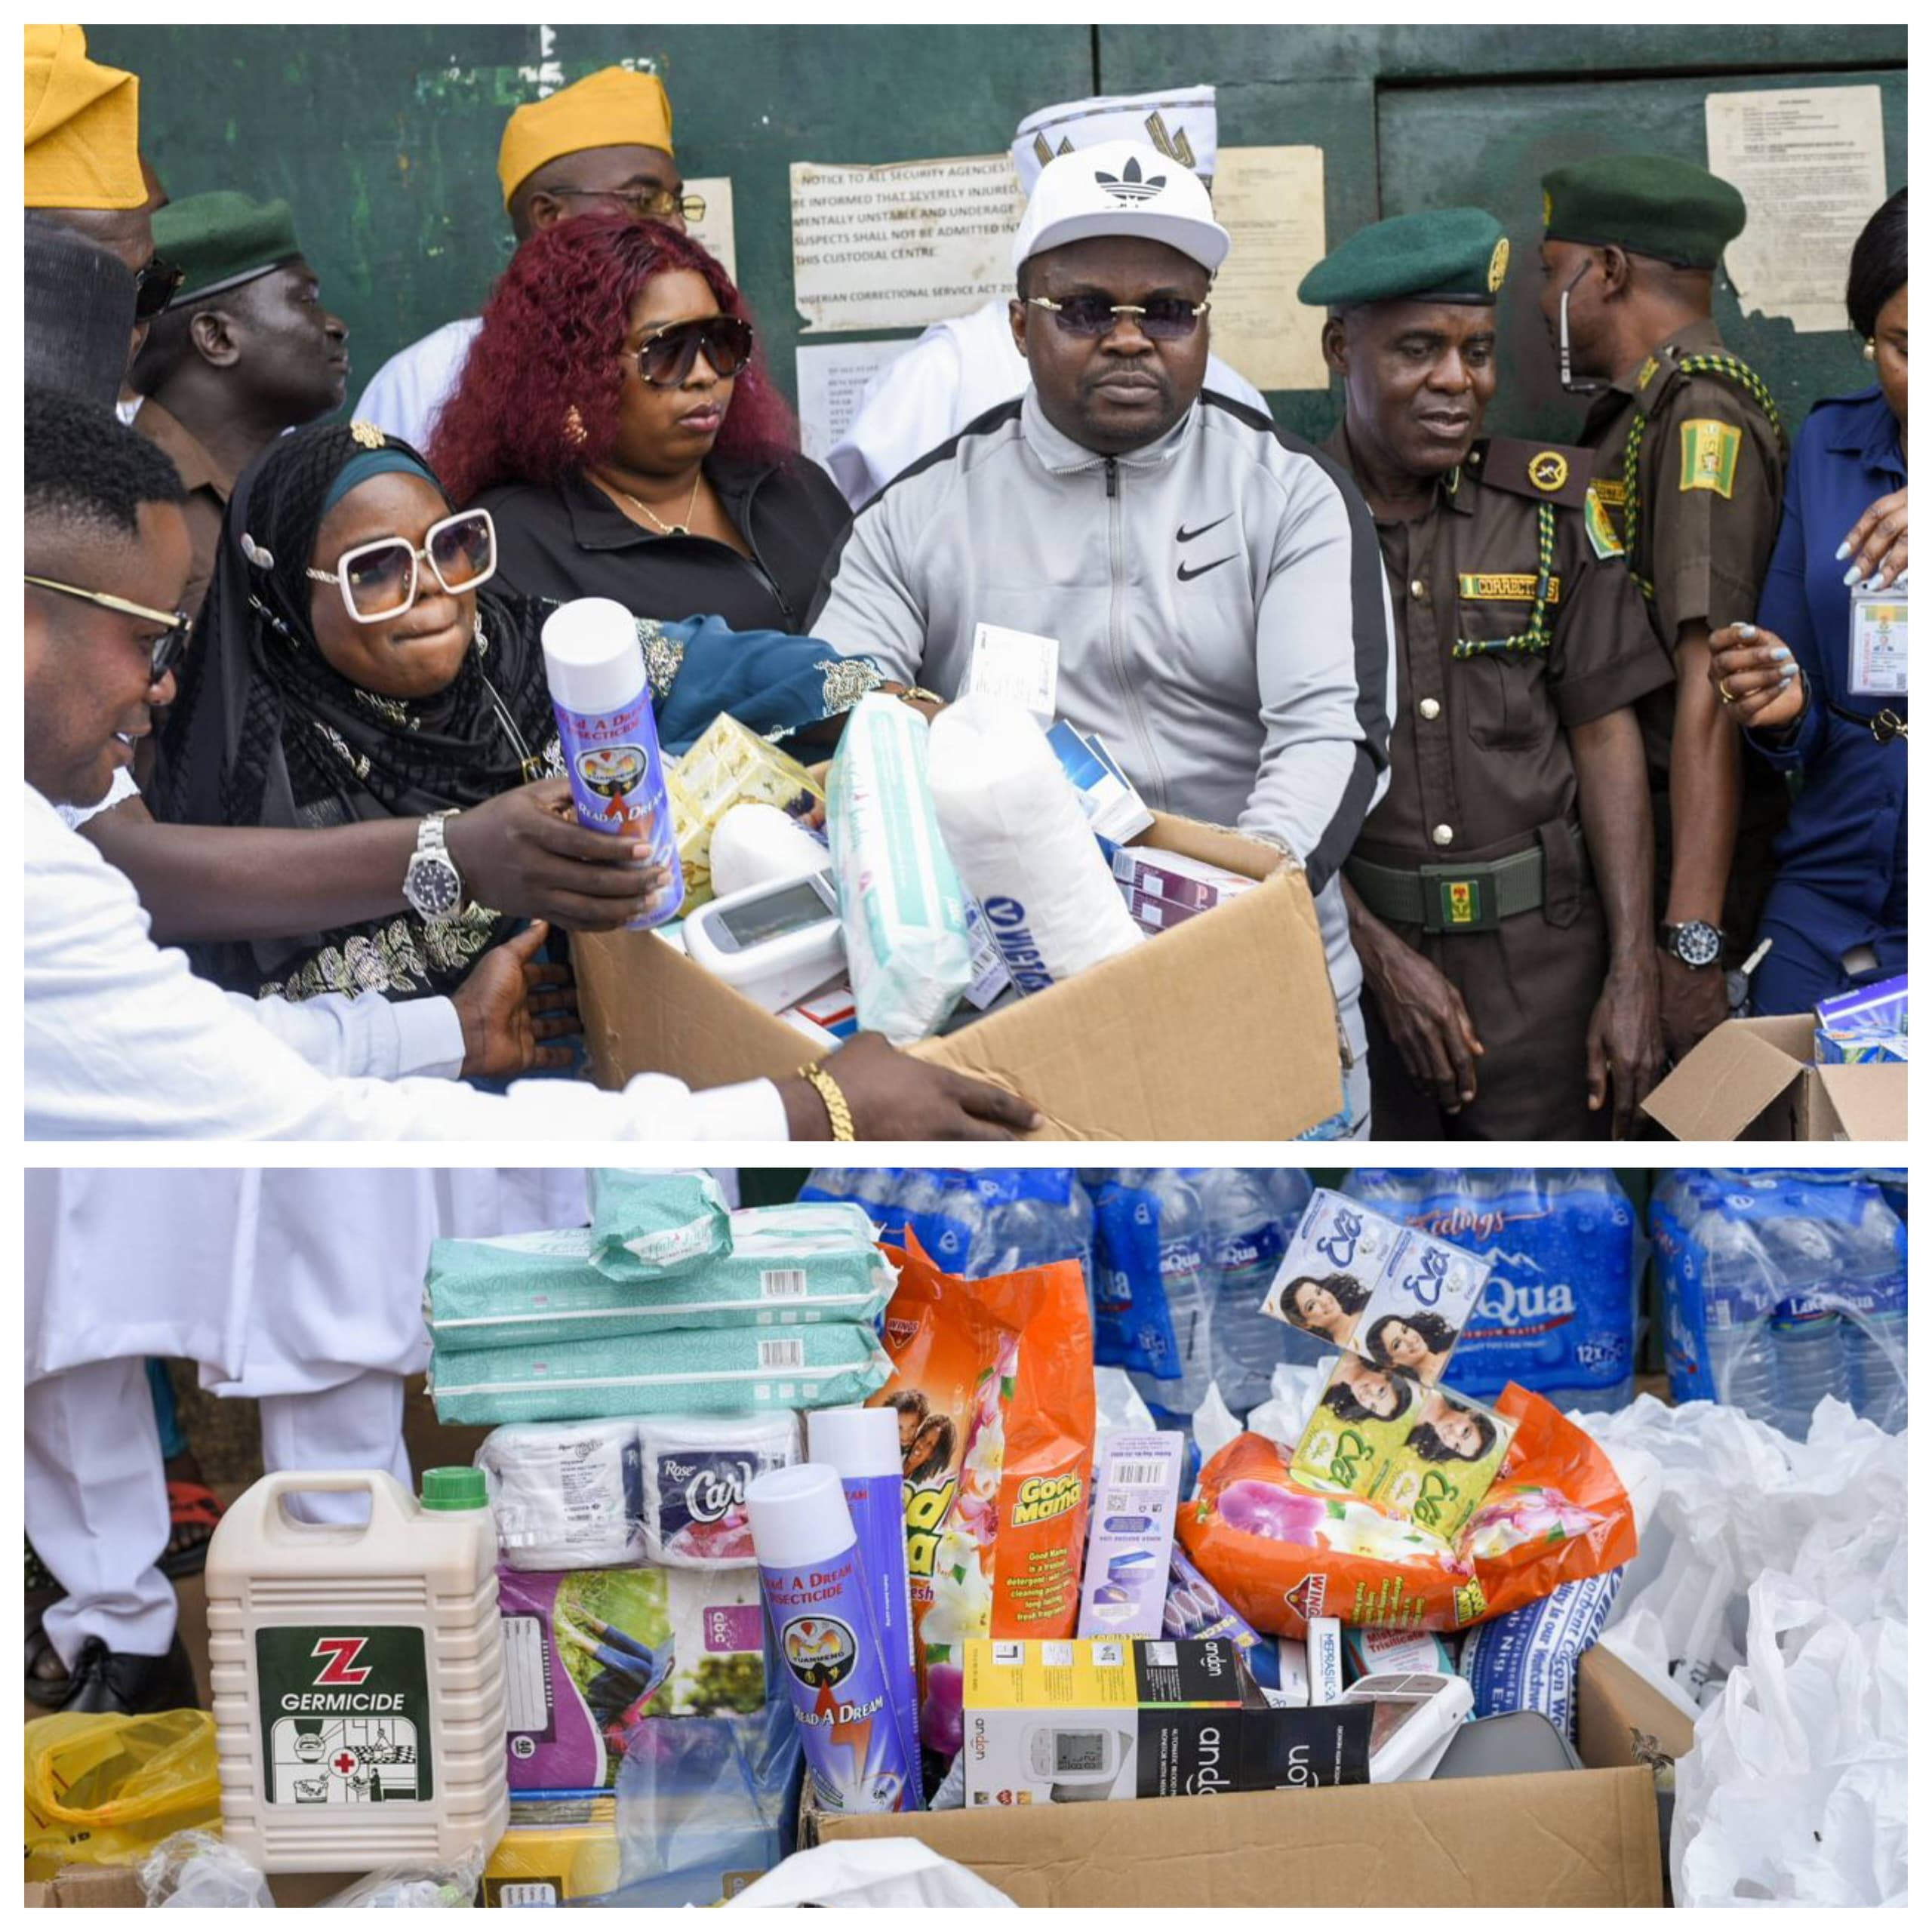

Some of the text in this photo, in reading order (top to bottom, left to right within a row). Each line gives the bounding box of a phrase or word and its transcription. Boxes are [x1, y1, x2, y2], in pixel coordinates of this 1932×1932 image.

[801, 174, 843, 186] NOTICE
[849, 174, 864, 183] TO
[868, 172, 886, 183] ALL
[891, 168, 943, 181] SECURITY
[809, 195, 872, 208] INFORMED
[876, 192, 906, 203] THAT
[908, 189, 964, 202] SEVERELY
[793, 204, 1014, 226] MENTALLY UNSTABLE AND UNDERAGE
[795, 233, 850, 246] SUSPECTS
[853, 231, 887, 242] SHALL
[891, 229, 915, 239] NOT
[919, 228, 933, 238] BE
[937, 225, 998, 237] ADMITTED
[795, 254, 820, 265] THIS
[823, 251, 888, 264] CUSTODIAL
[798, 293, 847, 304] NIGERIAN
[850, 288, 929, 302] CORRECTIONAL
[933, 285, 973, 297] SERVICE
[977, 284, 997, 294] ACT
[612, 810, 623, 823] A
[1316, 1206, 1364, 1268] Eva
[1403, 1246, 1451, 1307] Eva
[1472, 1277, 1576, 1326] Qua
[888, 1318, 918, 1333] WINGS
[663, 1460, 695, 1481] Rose
[1329, 1429, 1375, 1490] Eva
[1020, 1472, 1076, 1503] Good
[1414, 1469, 1459, 1527] Eva
[1014, 1484, 1081, 1524] Mama
[792, 1577, 803, 1589] A
[810, 1563, 853, 1587] DREAM
[911, 1586, 934, 1600] esh
[1309, 1574, 1325, 1617] WING
[713, 1611, 725, 1643] abc
[1368, 1631, 1425, 1653] Trisilicate
[310, 1636, 374, 1686] Z
[1205, 1641, 1227, 1677] andon
[281, 1693, 405, 1711] GERMICIDE
[823, 1708, 835, 1725] A
[839, 1695, 884, 1724] DREAM
[975, 1718, 989, 1761] andon
